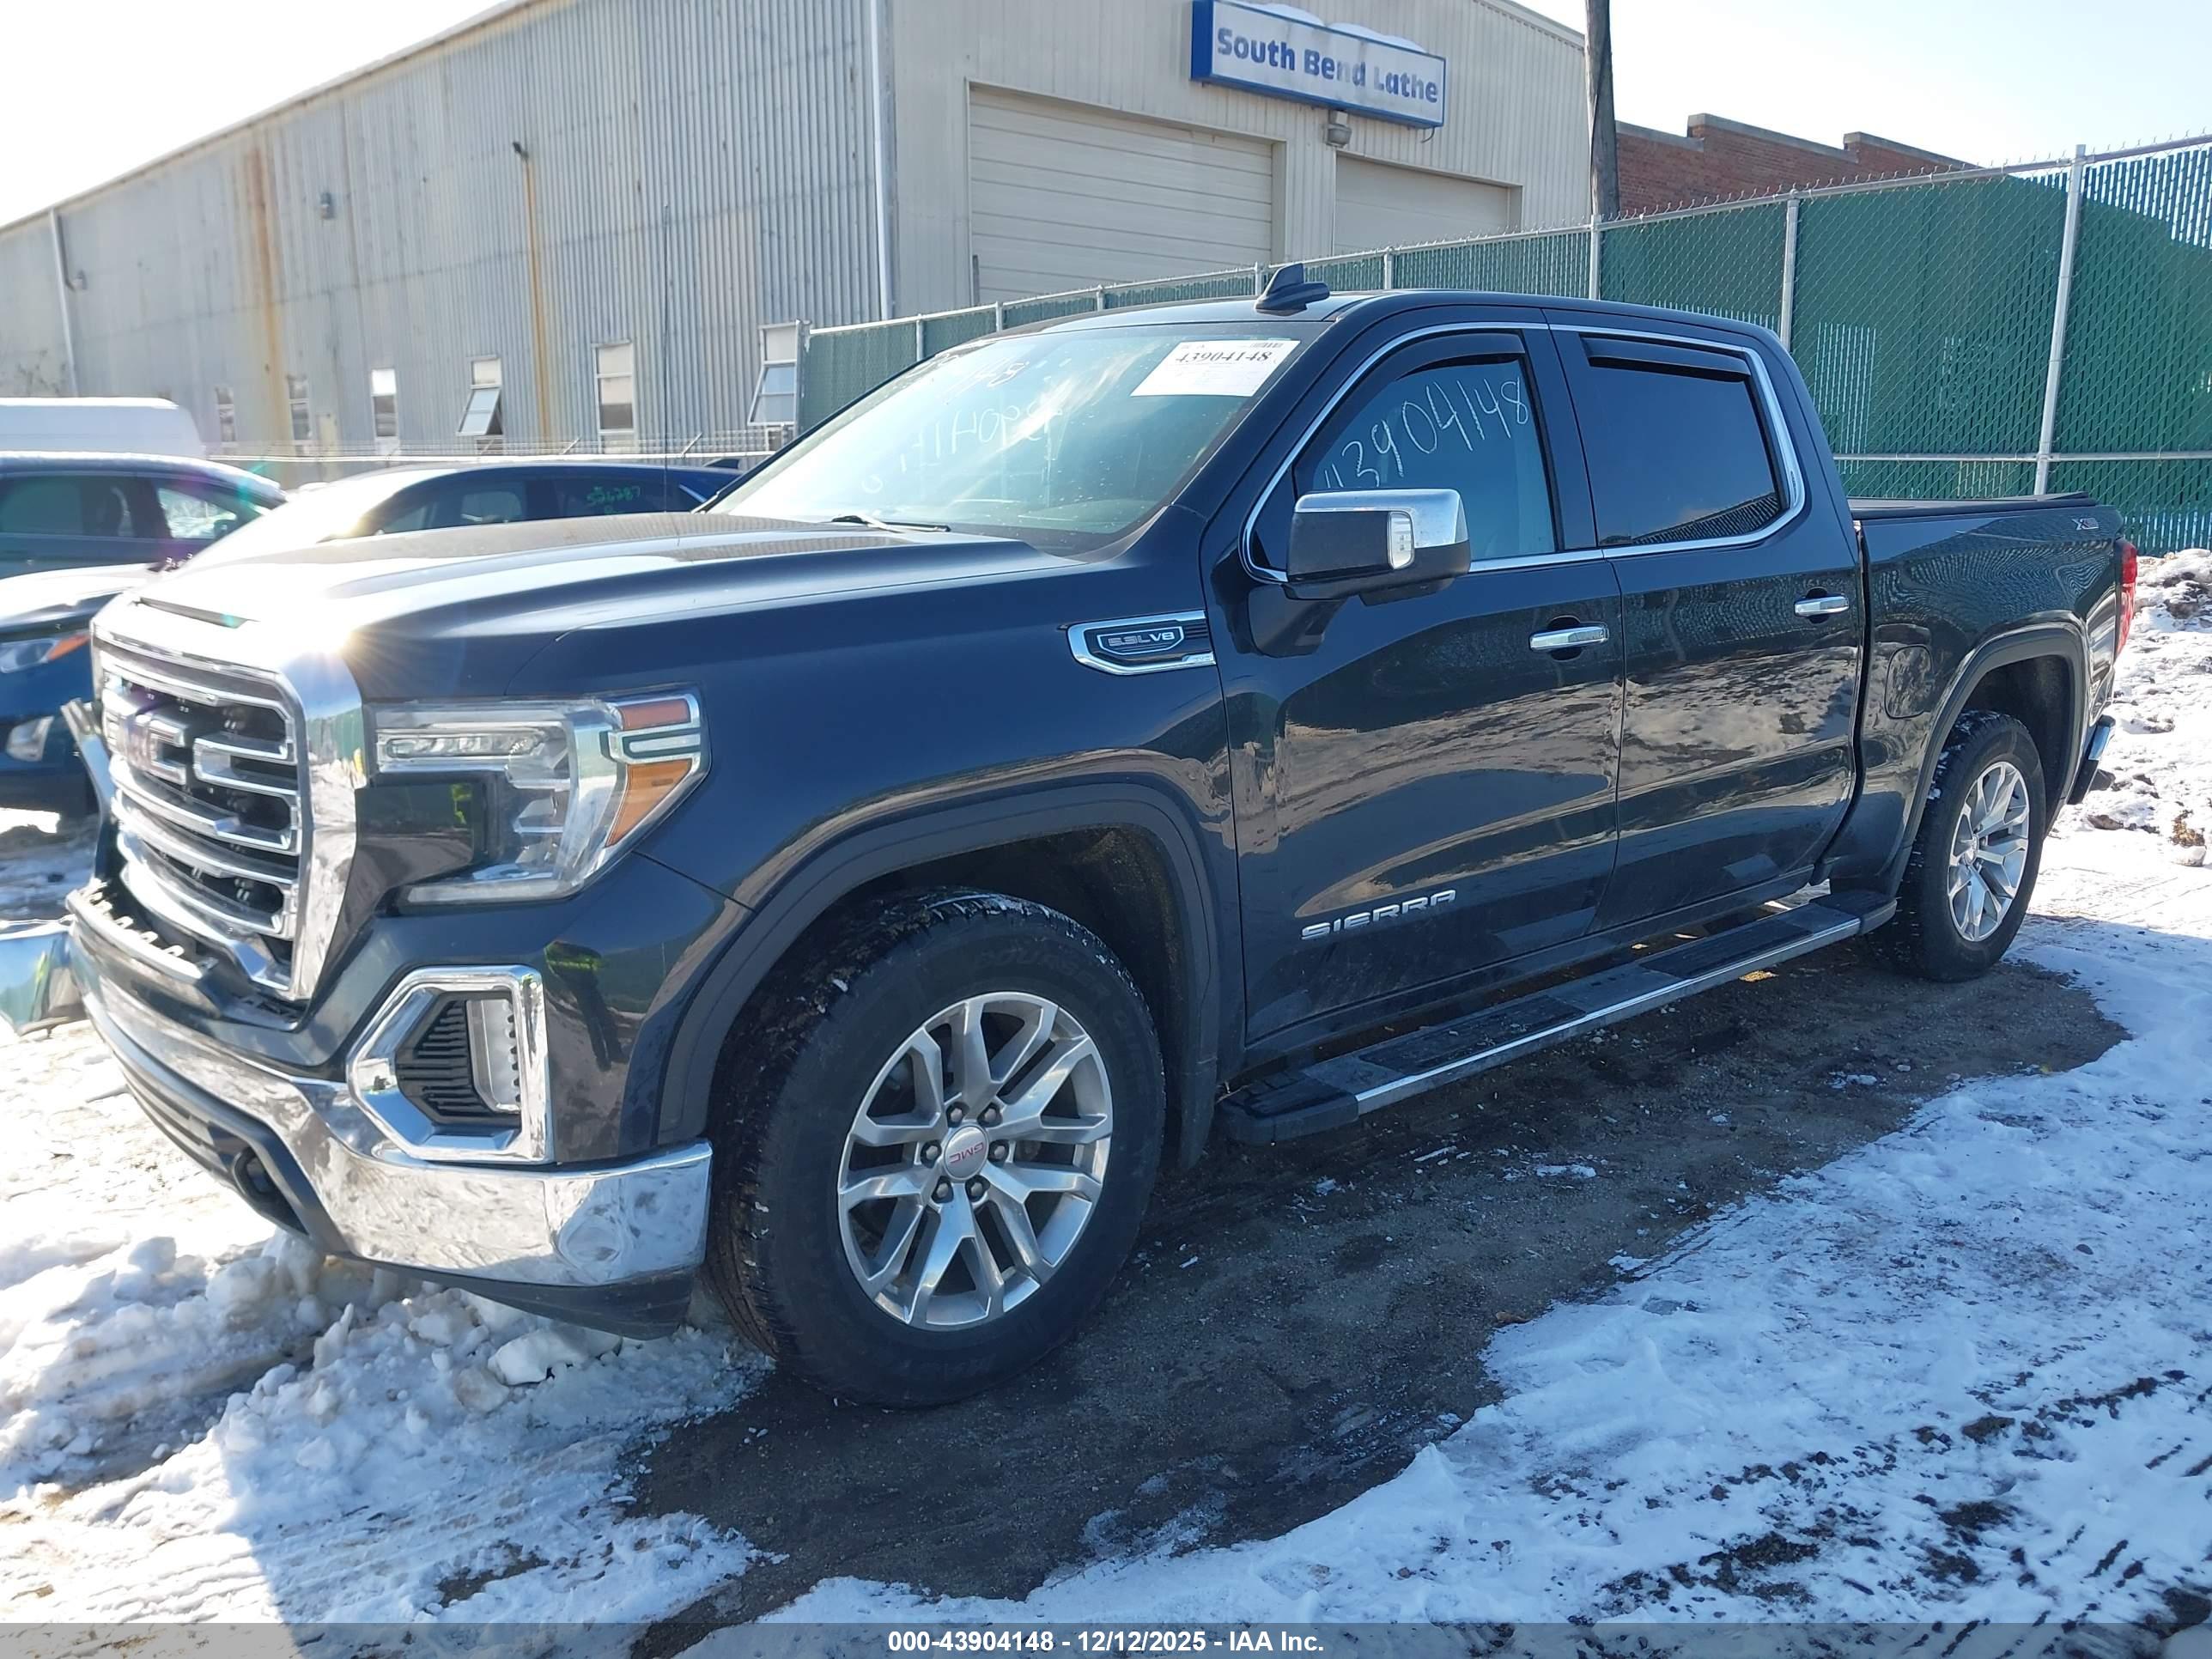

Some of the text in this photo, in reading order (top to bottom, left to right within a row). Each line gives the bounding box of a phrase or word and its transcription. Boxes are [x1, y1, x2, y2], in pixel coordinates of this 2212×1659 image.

[1217, 27, 1438, 103] South Bend Lathe
[1175, 350, 1273, 363] 43904148
[1301, 889, 1456, 940] SIERRA
[949, 1142, 984, 1164] GMC
